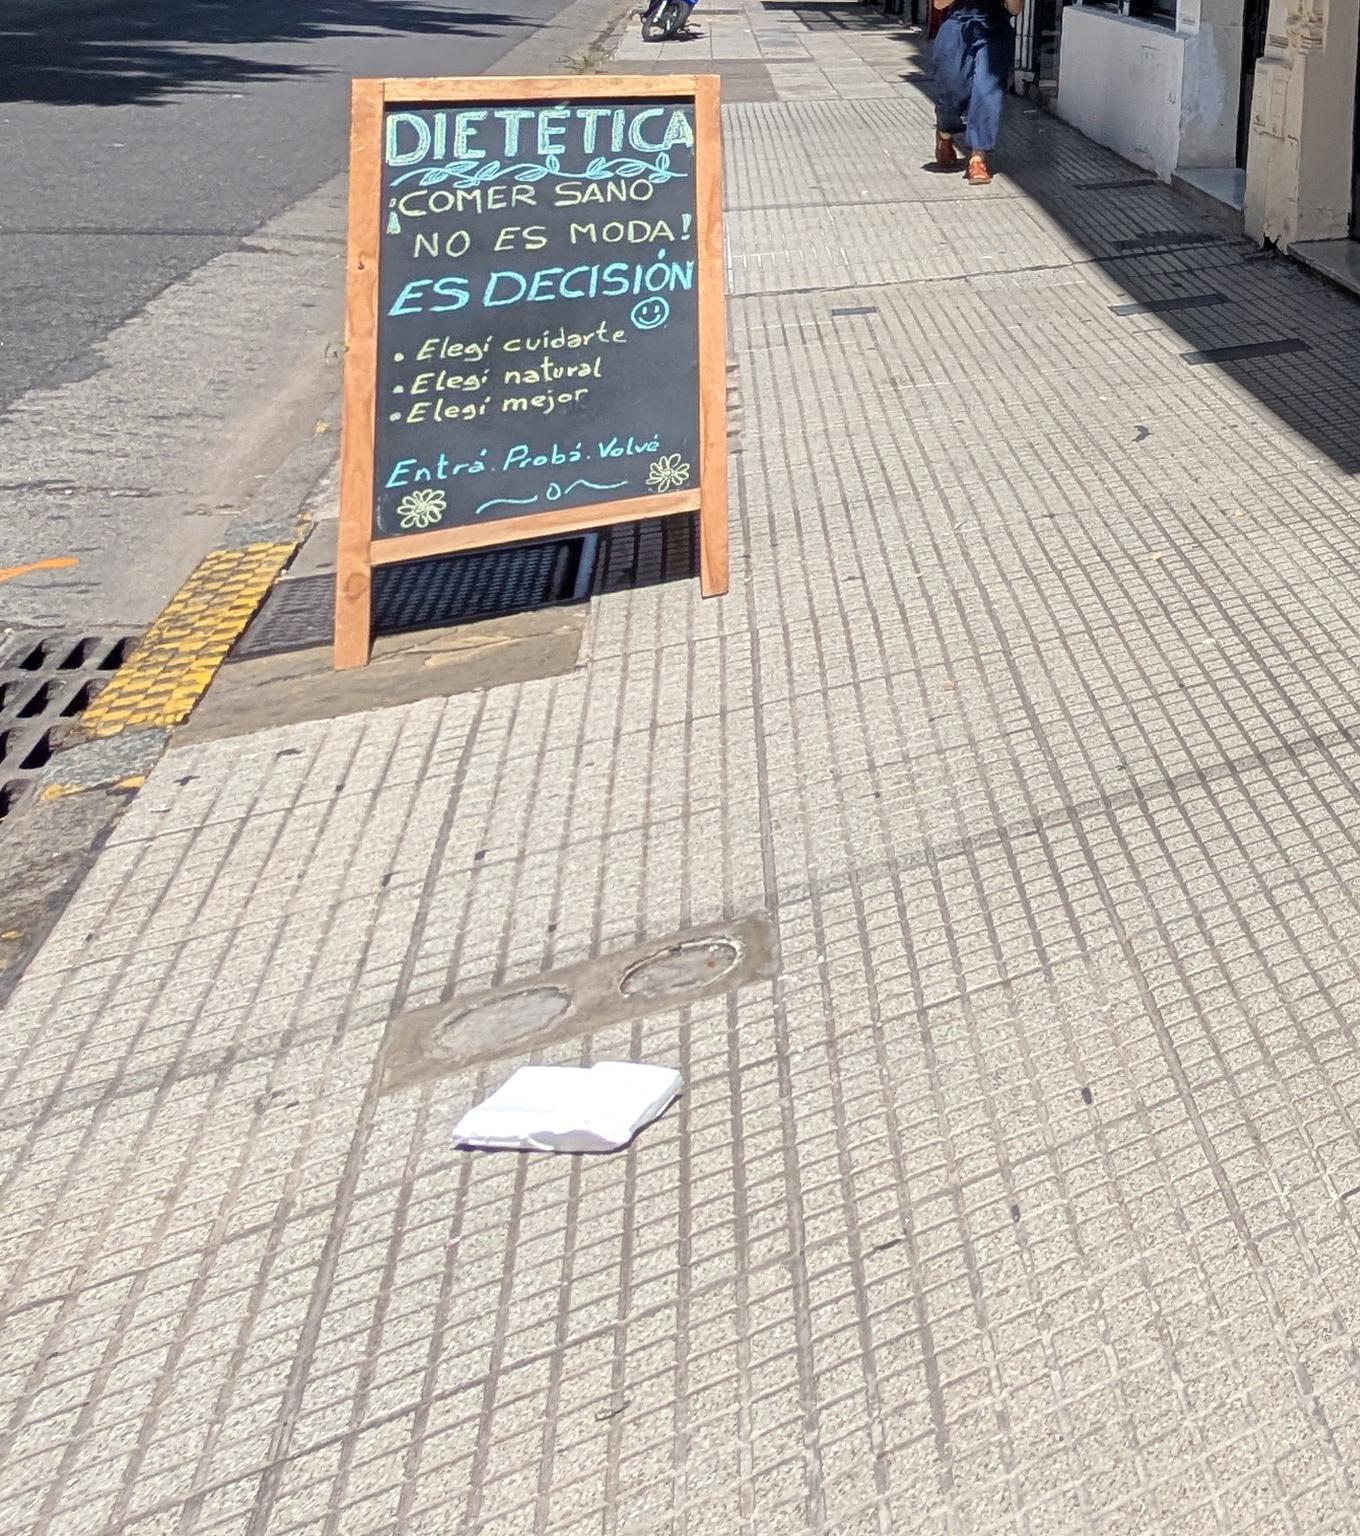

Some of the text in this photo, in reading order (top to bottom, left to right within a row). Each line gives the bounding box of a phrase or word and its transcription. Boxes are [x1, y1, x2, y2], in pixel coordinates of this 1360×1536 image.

[386, 102, 693, 165] DIETÉTICA
[554, 178, 655, 208] SANO
[413, 213, 692, 259] NO ES MODA!
[388, 248, 695, 317] ES DECISIÓN
[417, 321, 628, 363] Elegí cuidarte
[410, 356, 604, 396] Elegí natural
[407, 388, 589, 425] Elegí mejor
[598, 434, 661, 461] Volvé
